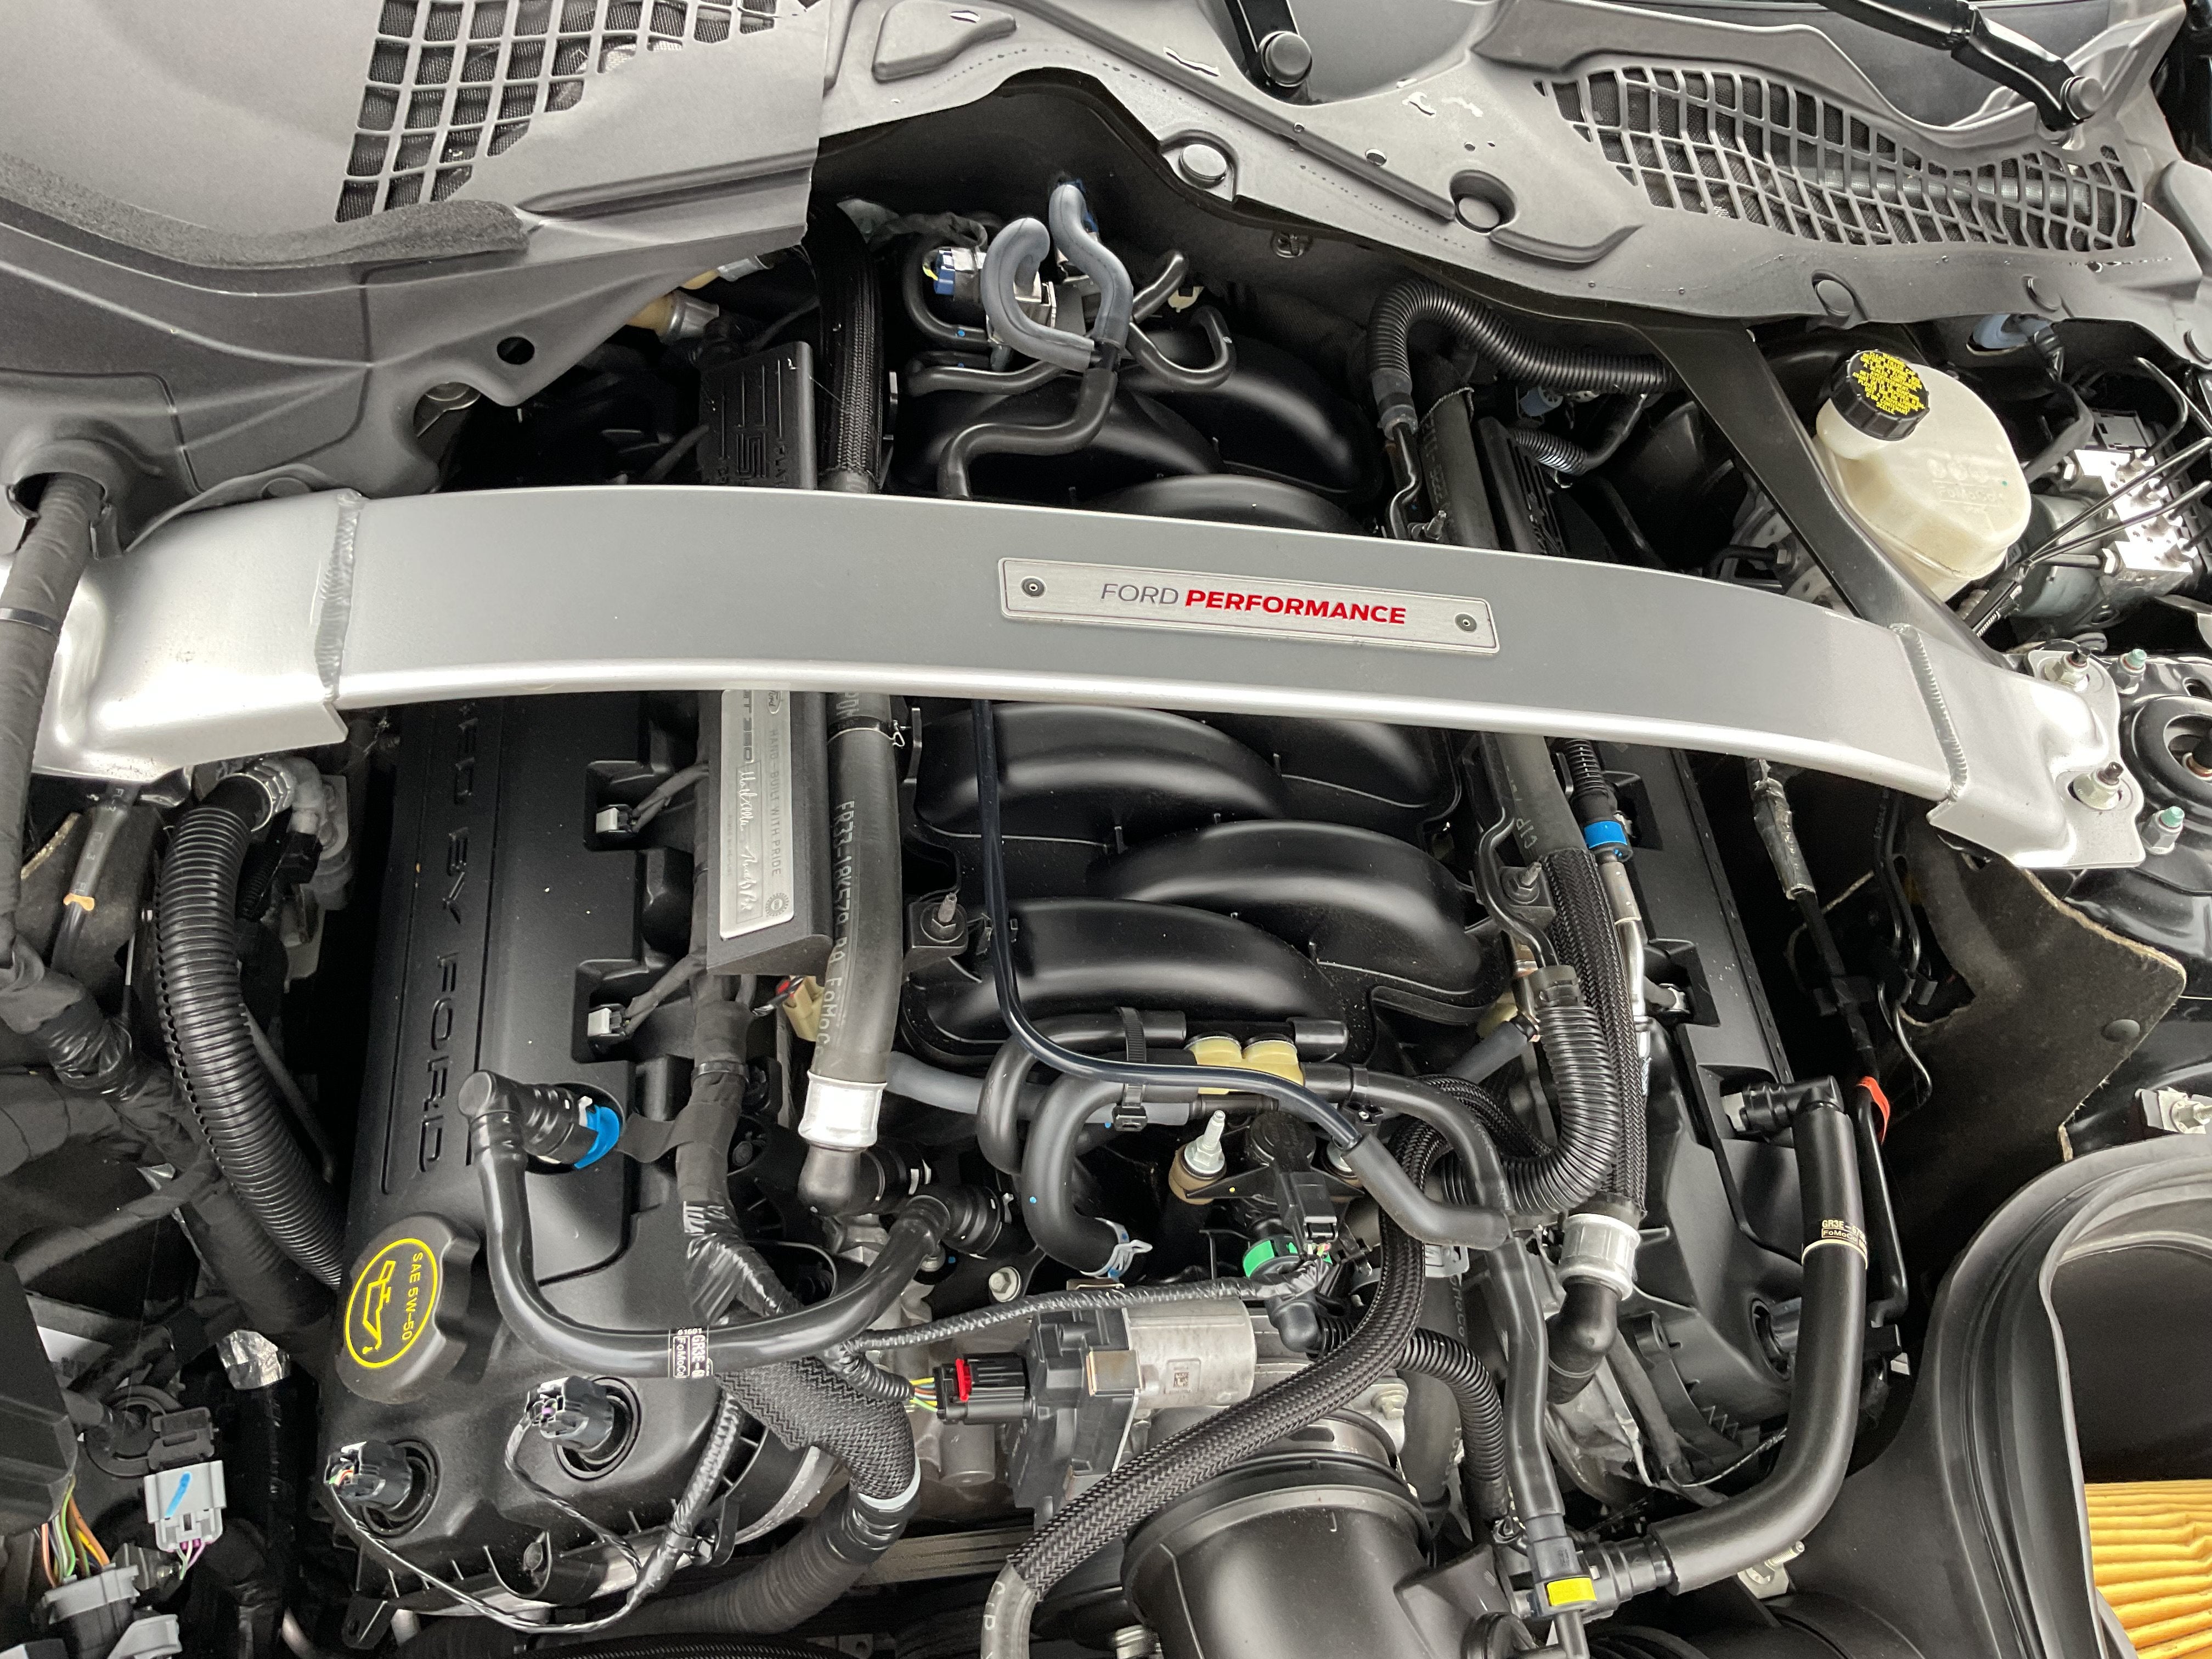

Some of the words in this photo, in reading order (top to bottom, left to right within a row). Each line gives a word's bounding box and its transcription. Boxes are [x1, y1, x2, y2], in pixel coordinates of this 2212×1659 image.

[1100, 583, 1179, 606] FORD
[1184, 589, 1407, 625] PERFORMANCE
[770, 807, 781, 836] WITH
[771, 840, 781, 876] PRIDE
[417, 953, 459, 1173] FORD
[1823, 1230, 1857, 1243] FoMoCo
[409, 1251, 424, 1283] SAE
[402, 1286, 421, 1340] 5W-50
[676, 1337, 686, 1376] FoMoCo
